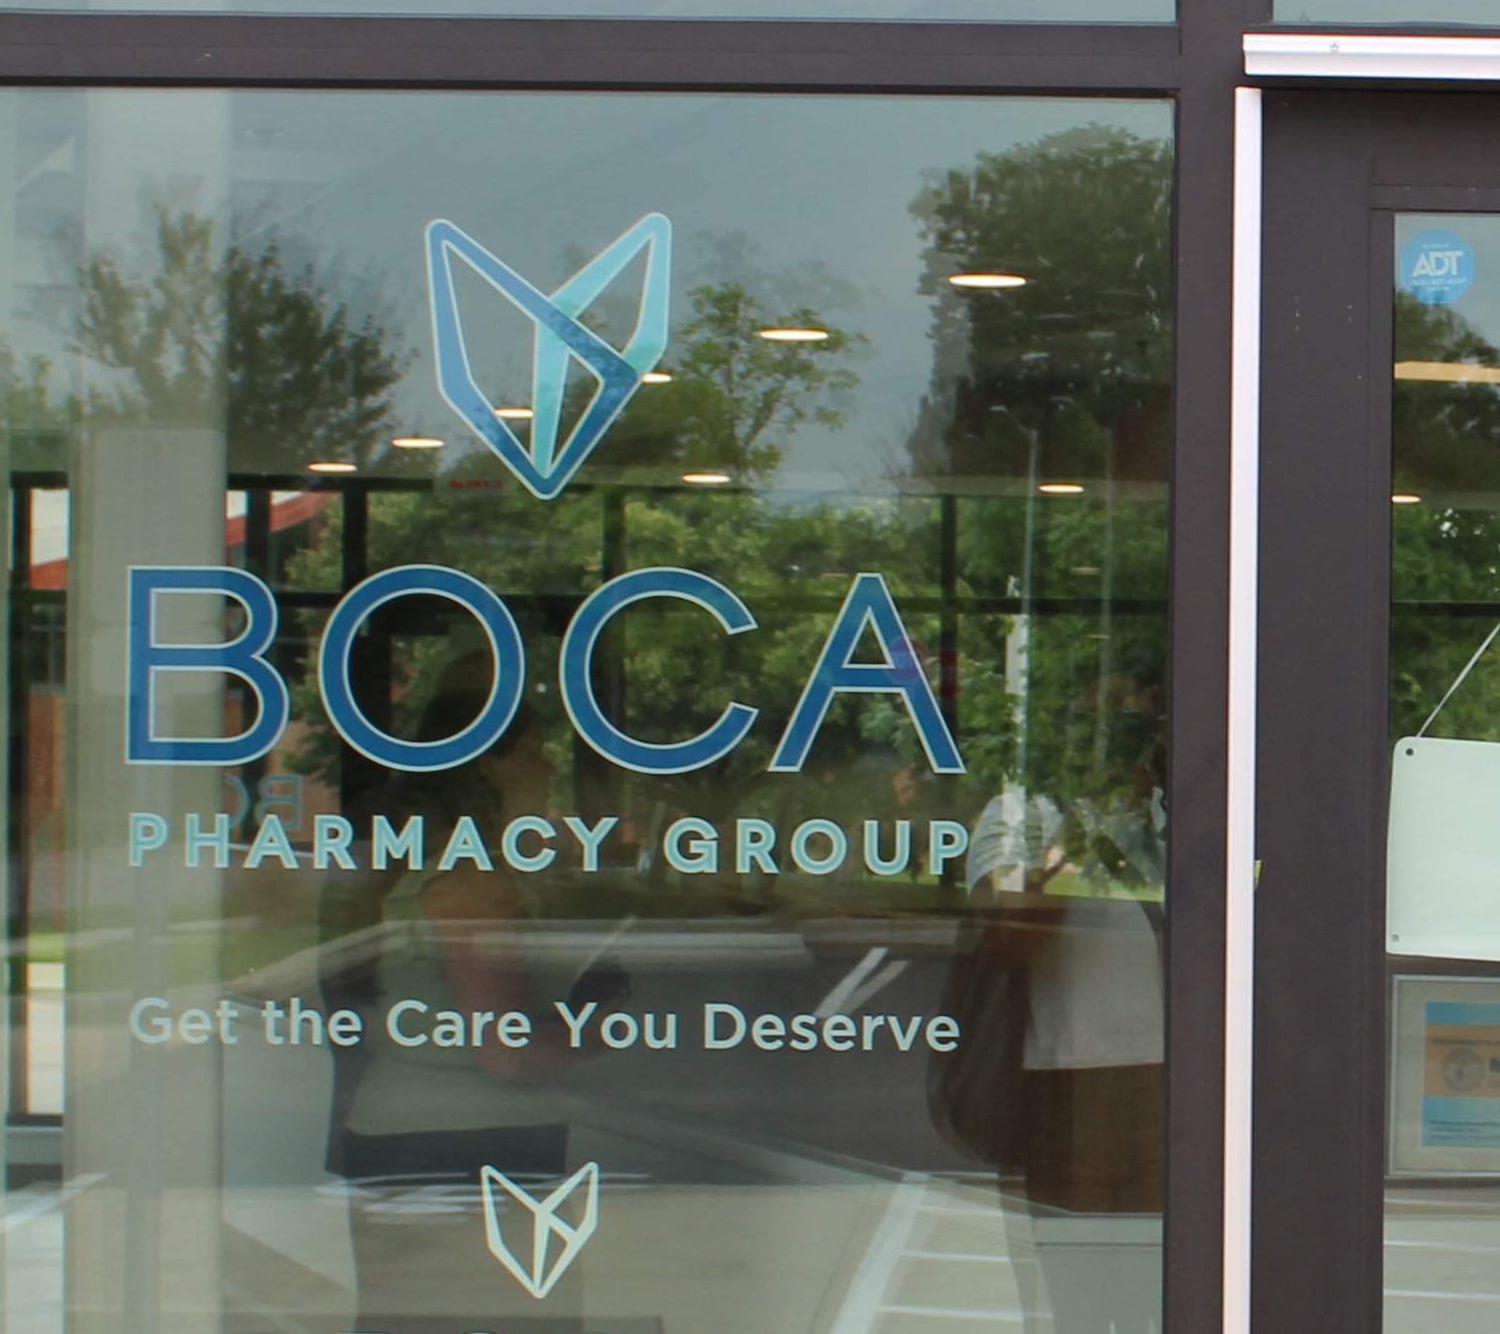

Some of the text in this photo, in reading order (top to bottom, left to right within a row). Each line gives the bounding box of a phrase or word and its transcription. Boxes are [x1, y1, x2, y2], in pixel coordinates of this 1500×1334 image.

[1411, 250, 1464, 277] ADT
[126, 565, 967, 774] BOCA
[127, 812, 970, 876] PHARMACY GROUP
[129, 997, 960, 1051] Get the Care You Deserve
